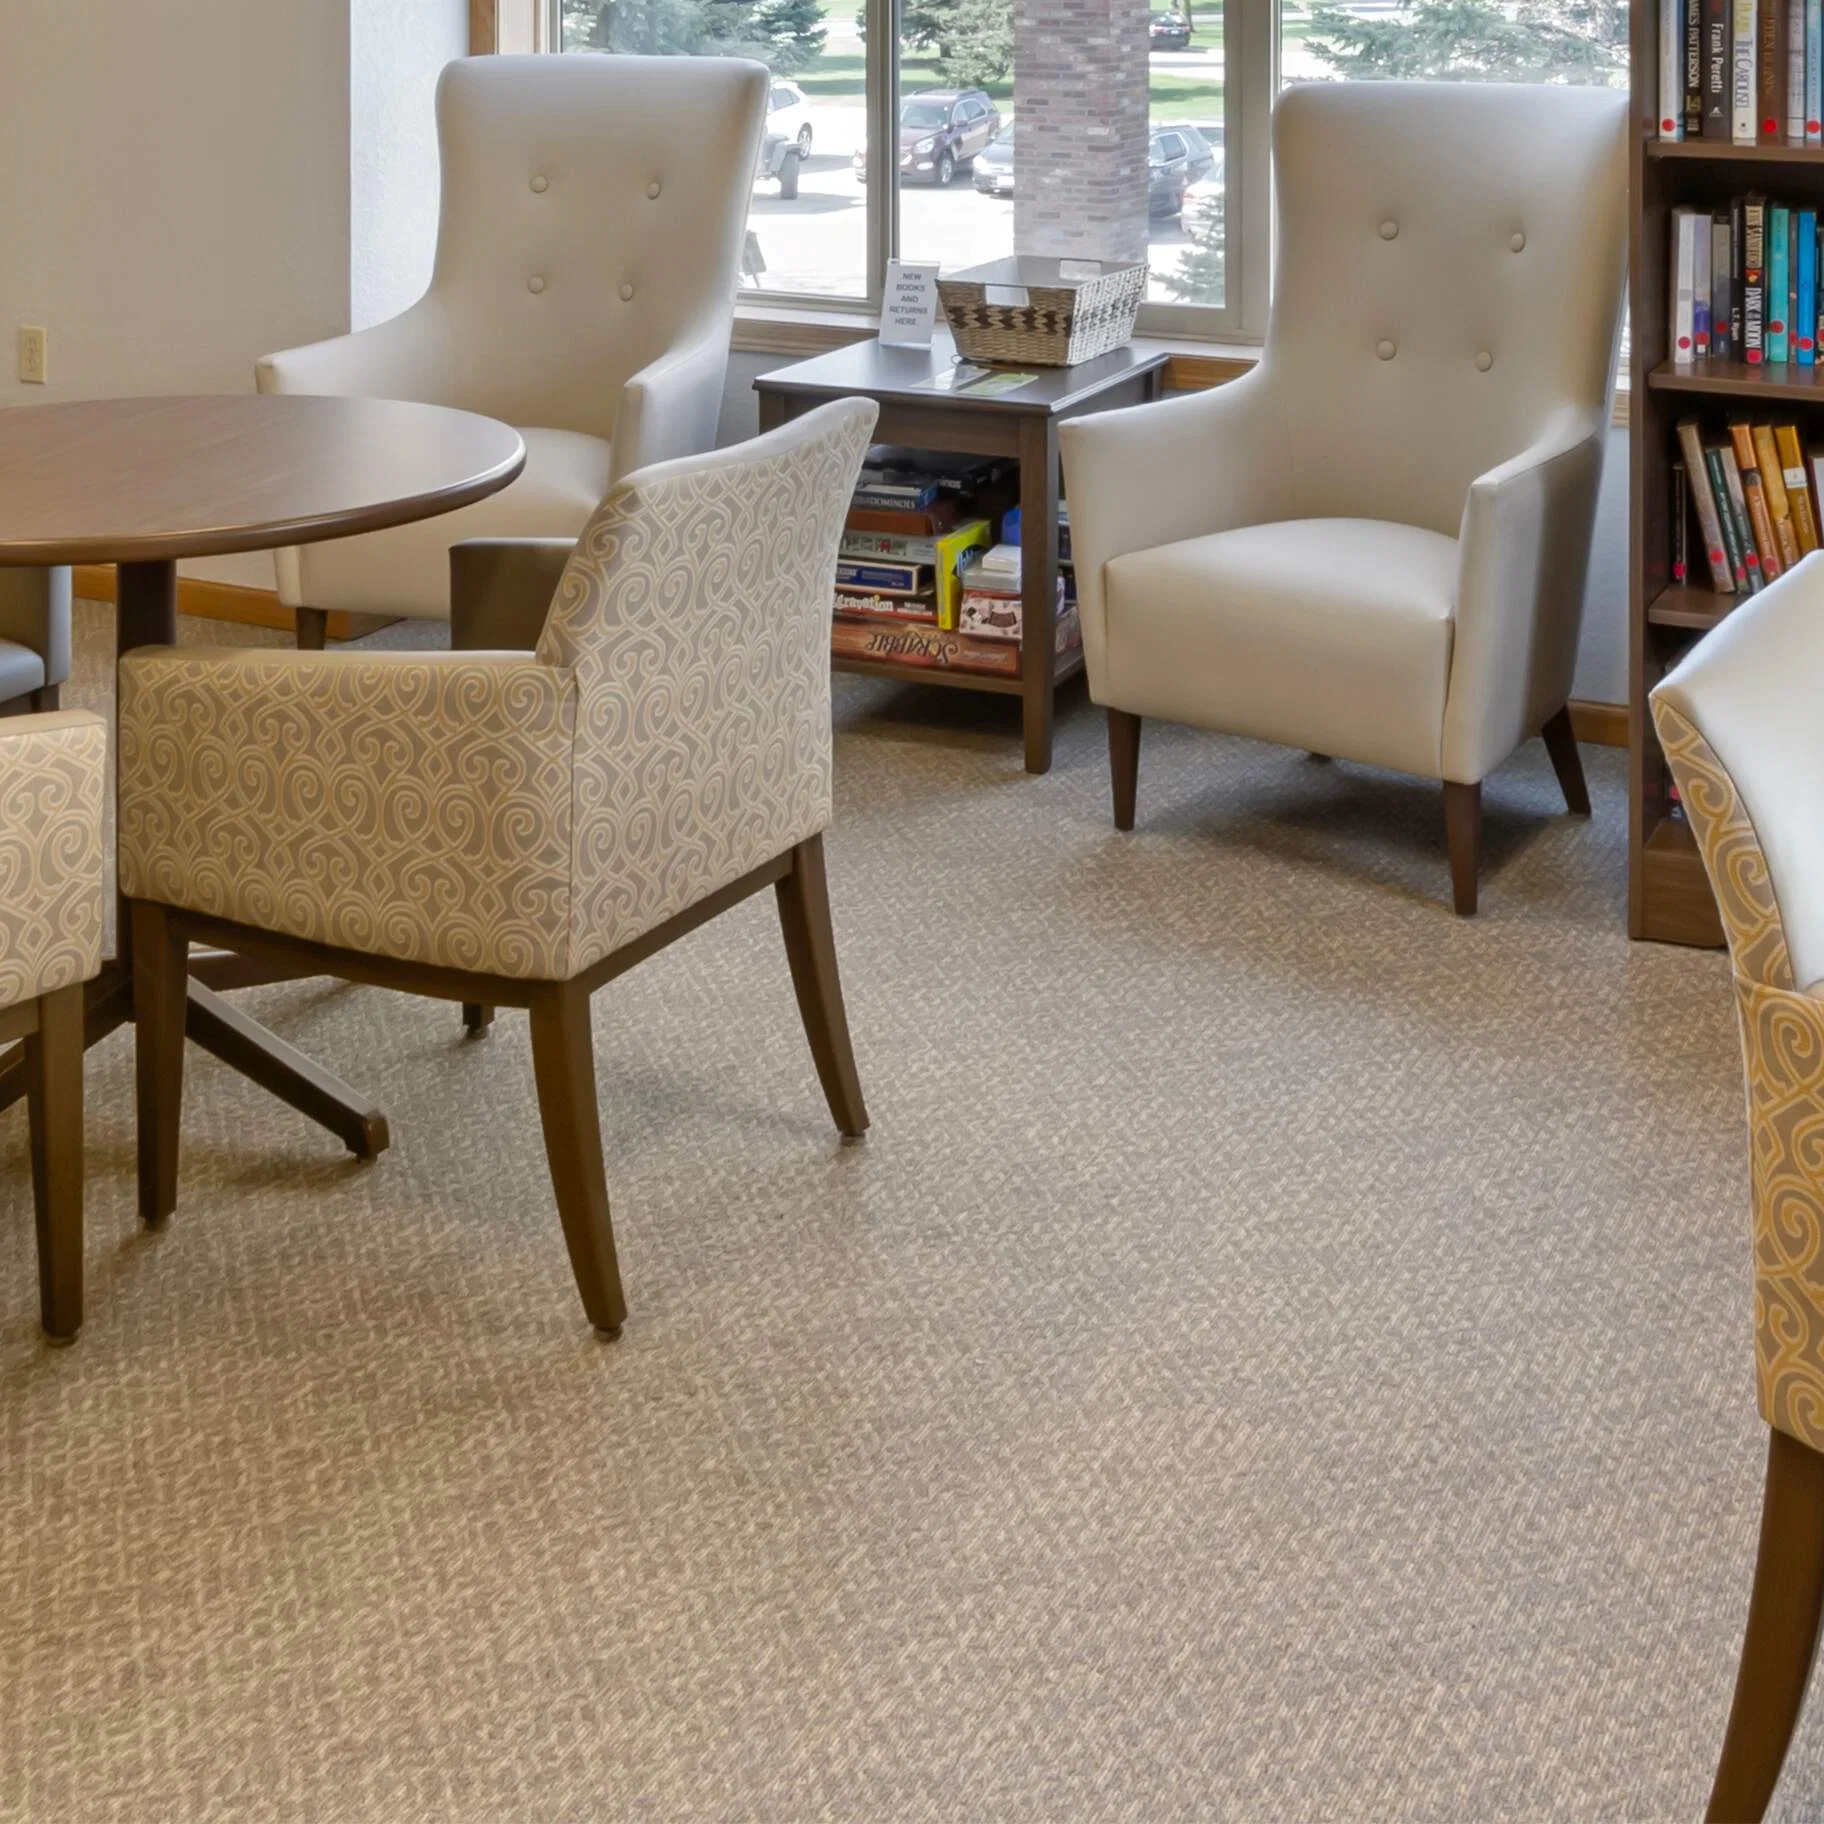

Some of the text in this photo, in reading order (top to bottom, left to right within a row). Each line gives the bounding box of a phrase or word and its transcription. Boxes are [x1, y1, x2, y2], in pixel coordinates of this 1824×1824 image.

[1688, 26, 1700, 88] PATTERSON
[1710, 22, 1724, 93] Frank Peretti
[1734, 39, 1754, 110] THE CAROUSEL
[896, 284, 926, 292] BOOKS
[902, 272, 922, 280] NEW
[890, 306, 928, 316] RETURNS
[1744, 288, 1762, 348] DARK MOON
[889, 497, 936, 509] DOMINOES
[864, 630, 960, 664] SCRABBLE
